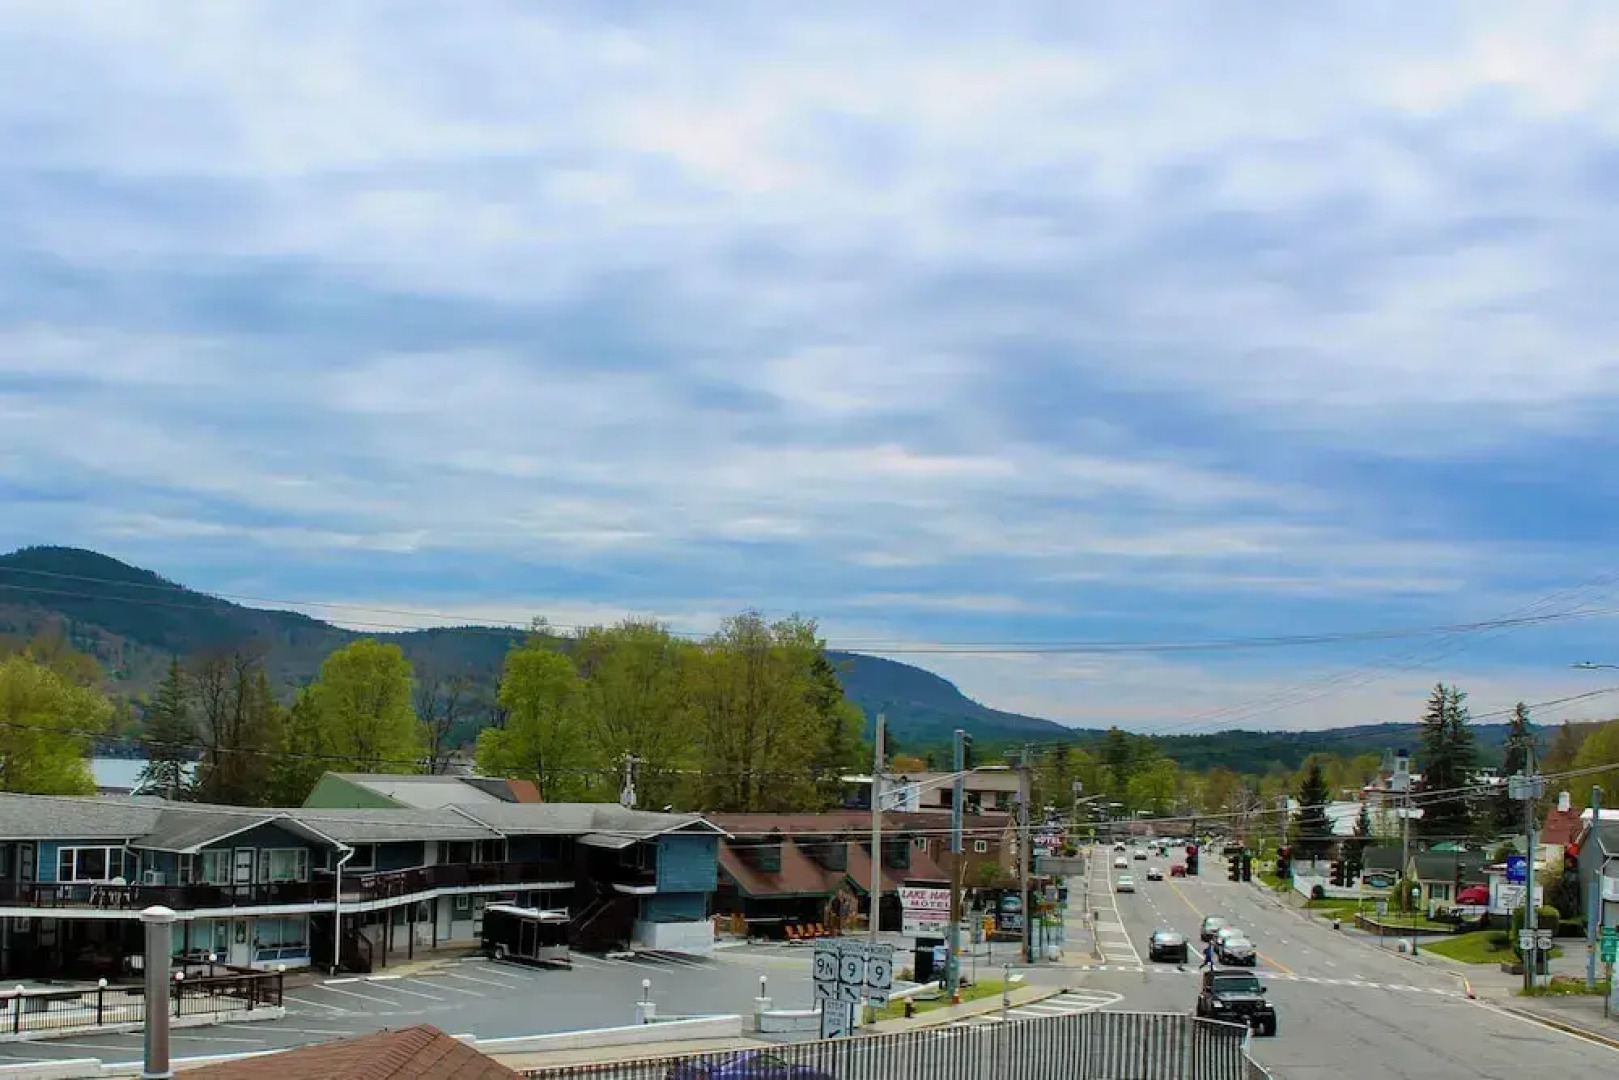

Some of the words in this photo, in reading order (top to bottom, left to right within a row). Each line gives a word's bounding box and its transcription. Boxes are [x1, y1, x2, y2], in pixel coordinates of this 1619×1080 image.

[901, 890, 926, 899] LAKE
[911, 900, 950, 908] MOTEL
[817, 958, 833, 976] 9N
[848, 962, 856, 977] 9
[875, 965, 883, 981] 9
